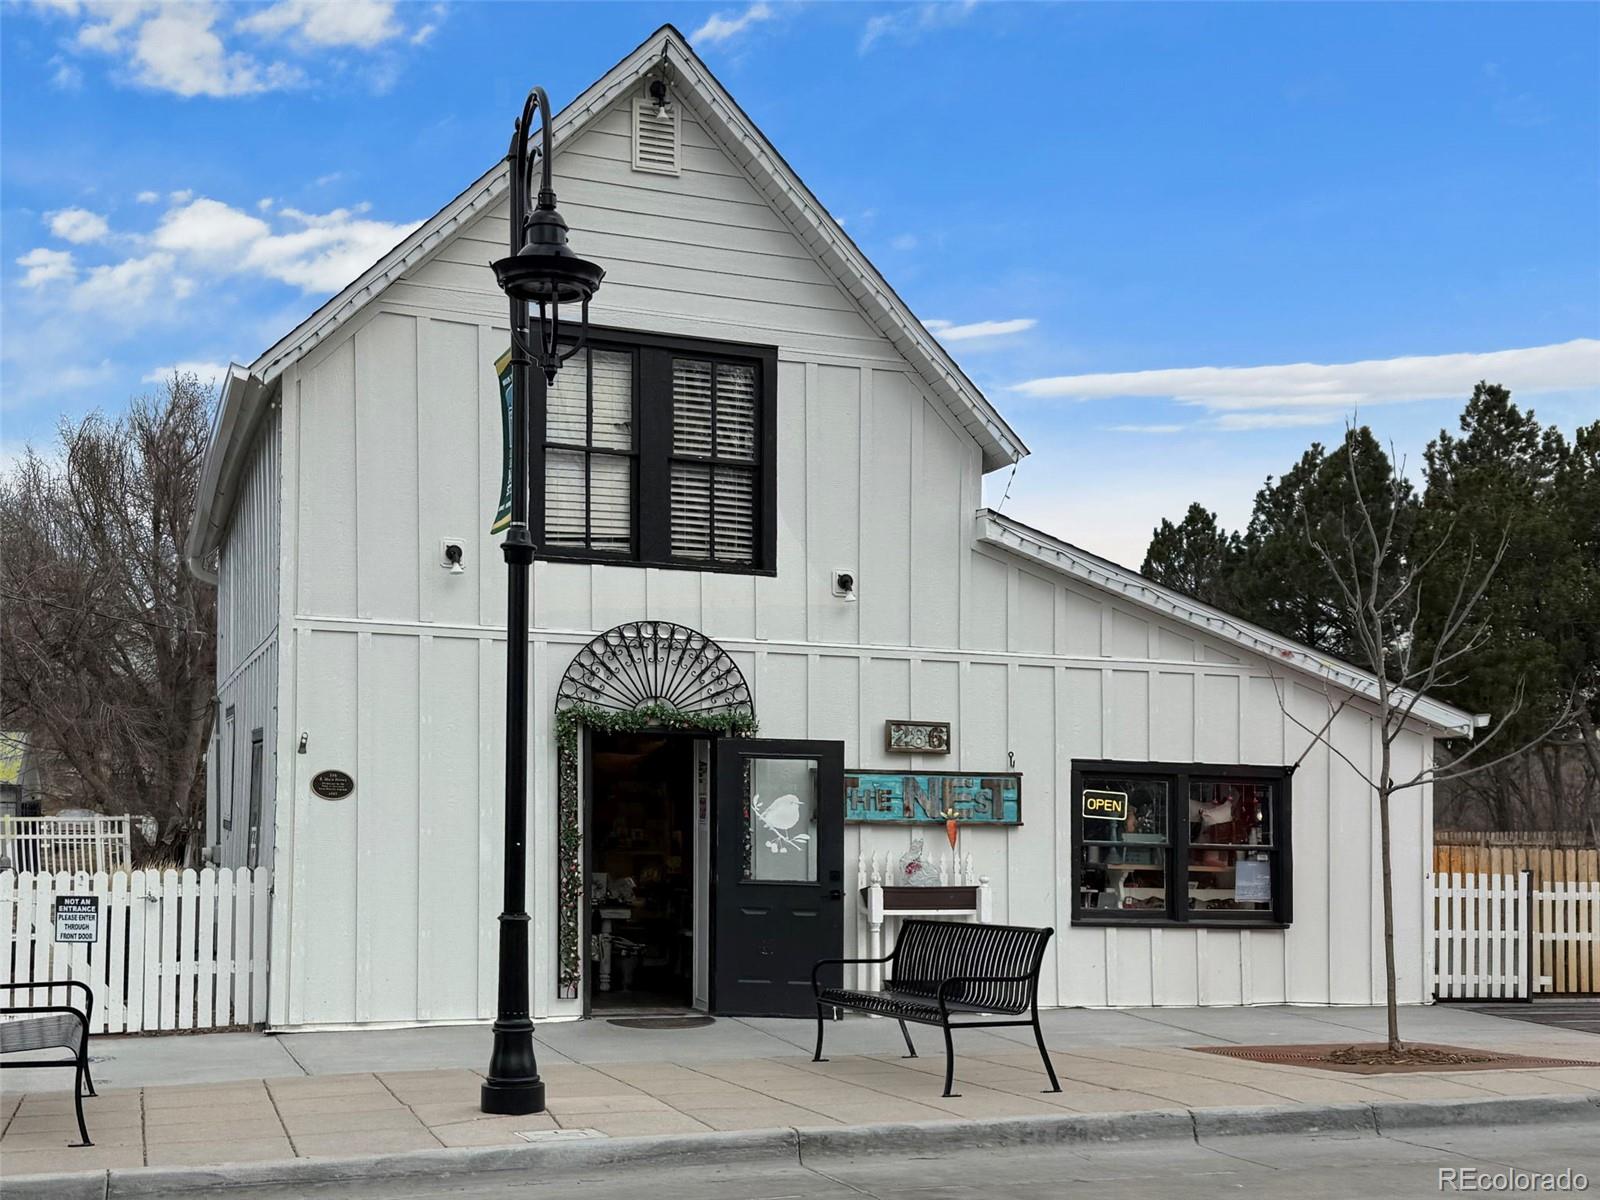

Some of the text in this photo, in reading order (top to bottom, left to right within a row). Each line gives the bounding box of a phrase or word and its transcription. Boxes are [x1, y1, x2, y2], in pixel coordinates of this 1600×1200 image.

[892, 725, 945, 749] 286
[903, 776, 1017, 819] NEST
[1087, 798, 1122, 812] OPEN
[60, 932, 93, 940] FRONT DOOR
